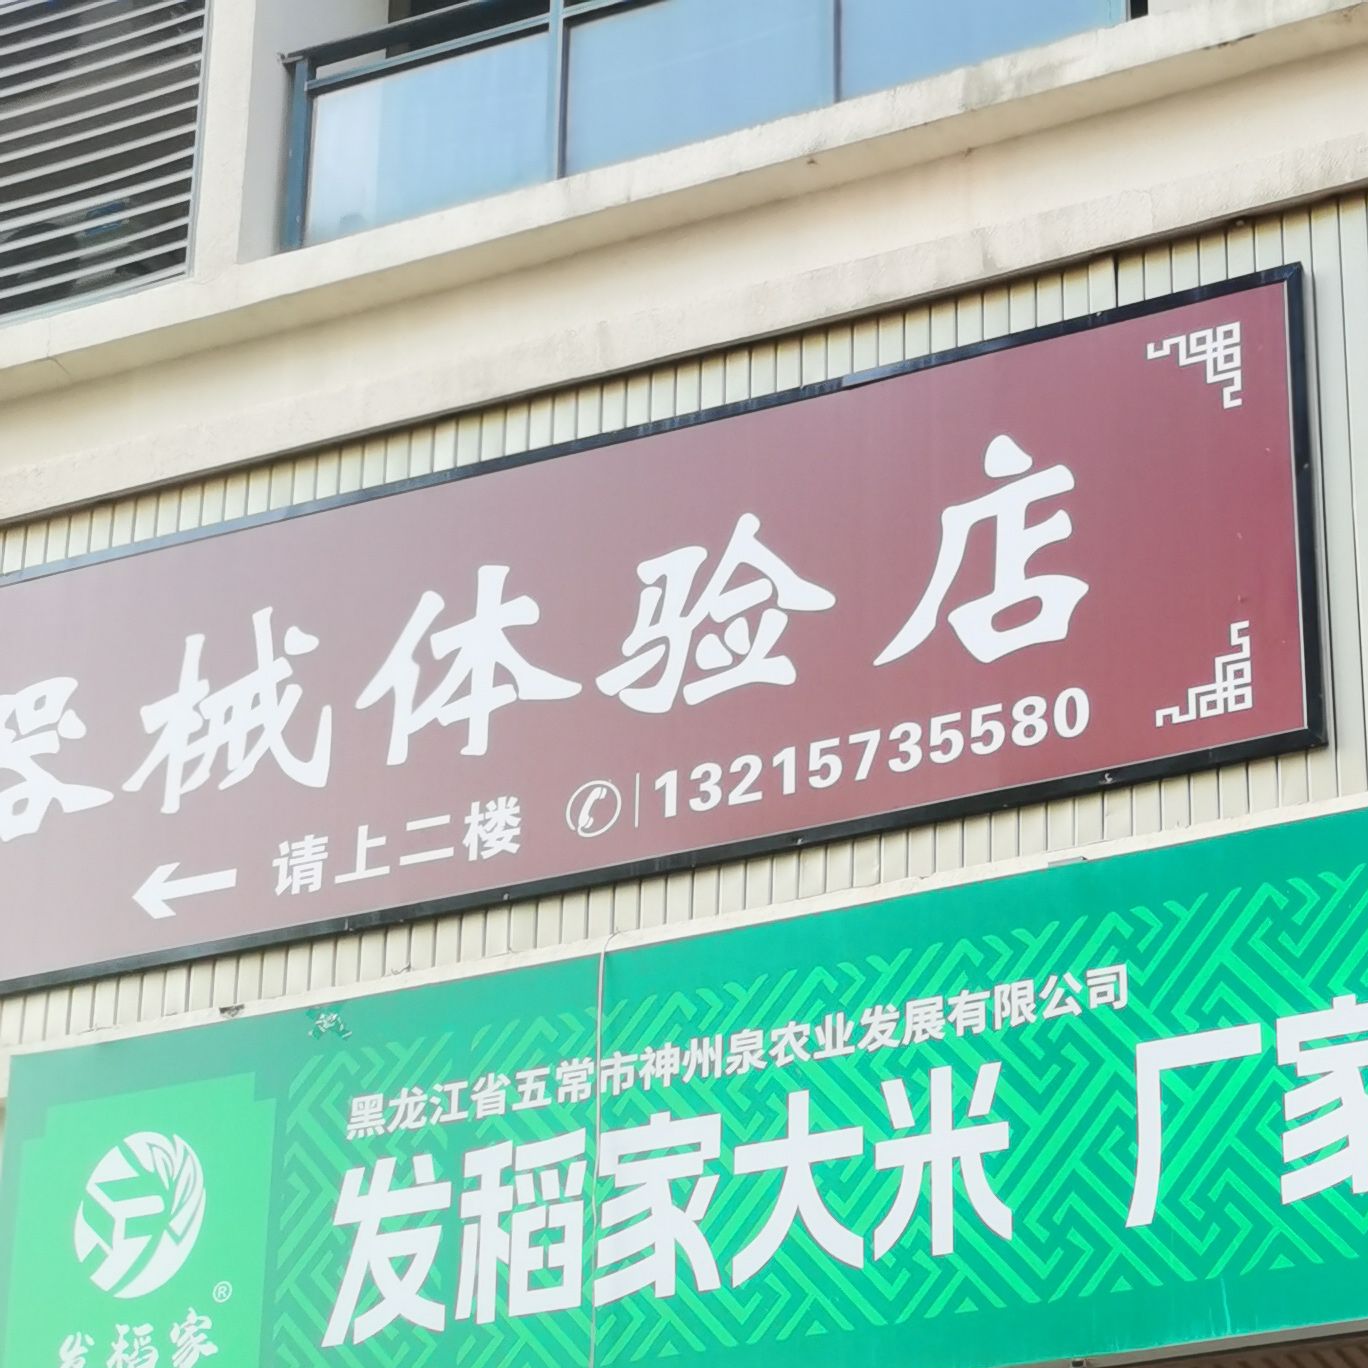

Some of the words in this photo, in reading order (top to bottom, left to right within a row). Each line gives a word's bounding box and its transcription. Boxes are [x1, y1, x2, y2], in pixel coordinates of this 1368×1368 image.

[272, 796, 521, 896] 请上二楼
[654, 686, 1090, 818] 13215735580
[345, 963, 1128, 1141] 黑龙江省五常市神州泉农业发展有限公司
[320, 1061, 1013, 1348] 发稻家大米
